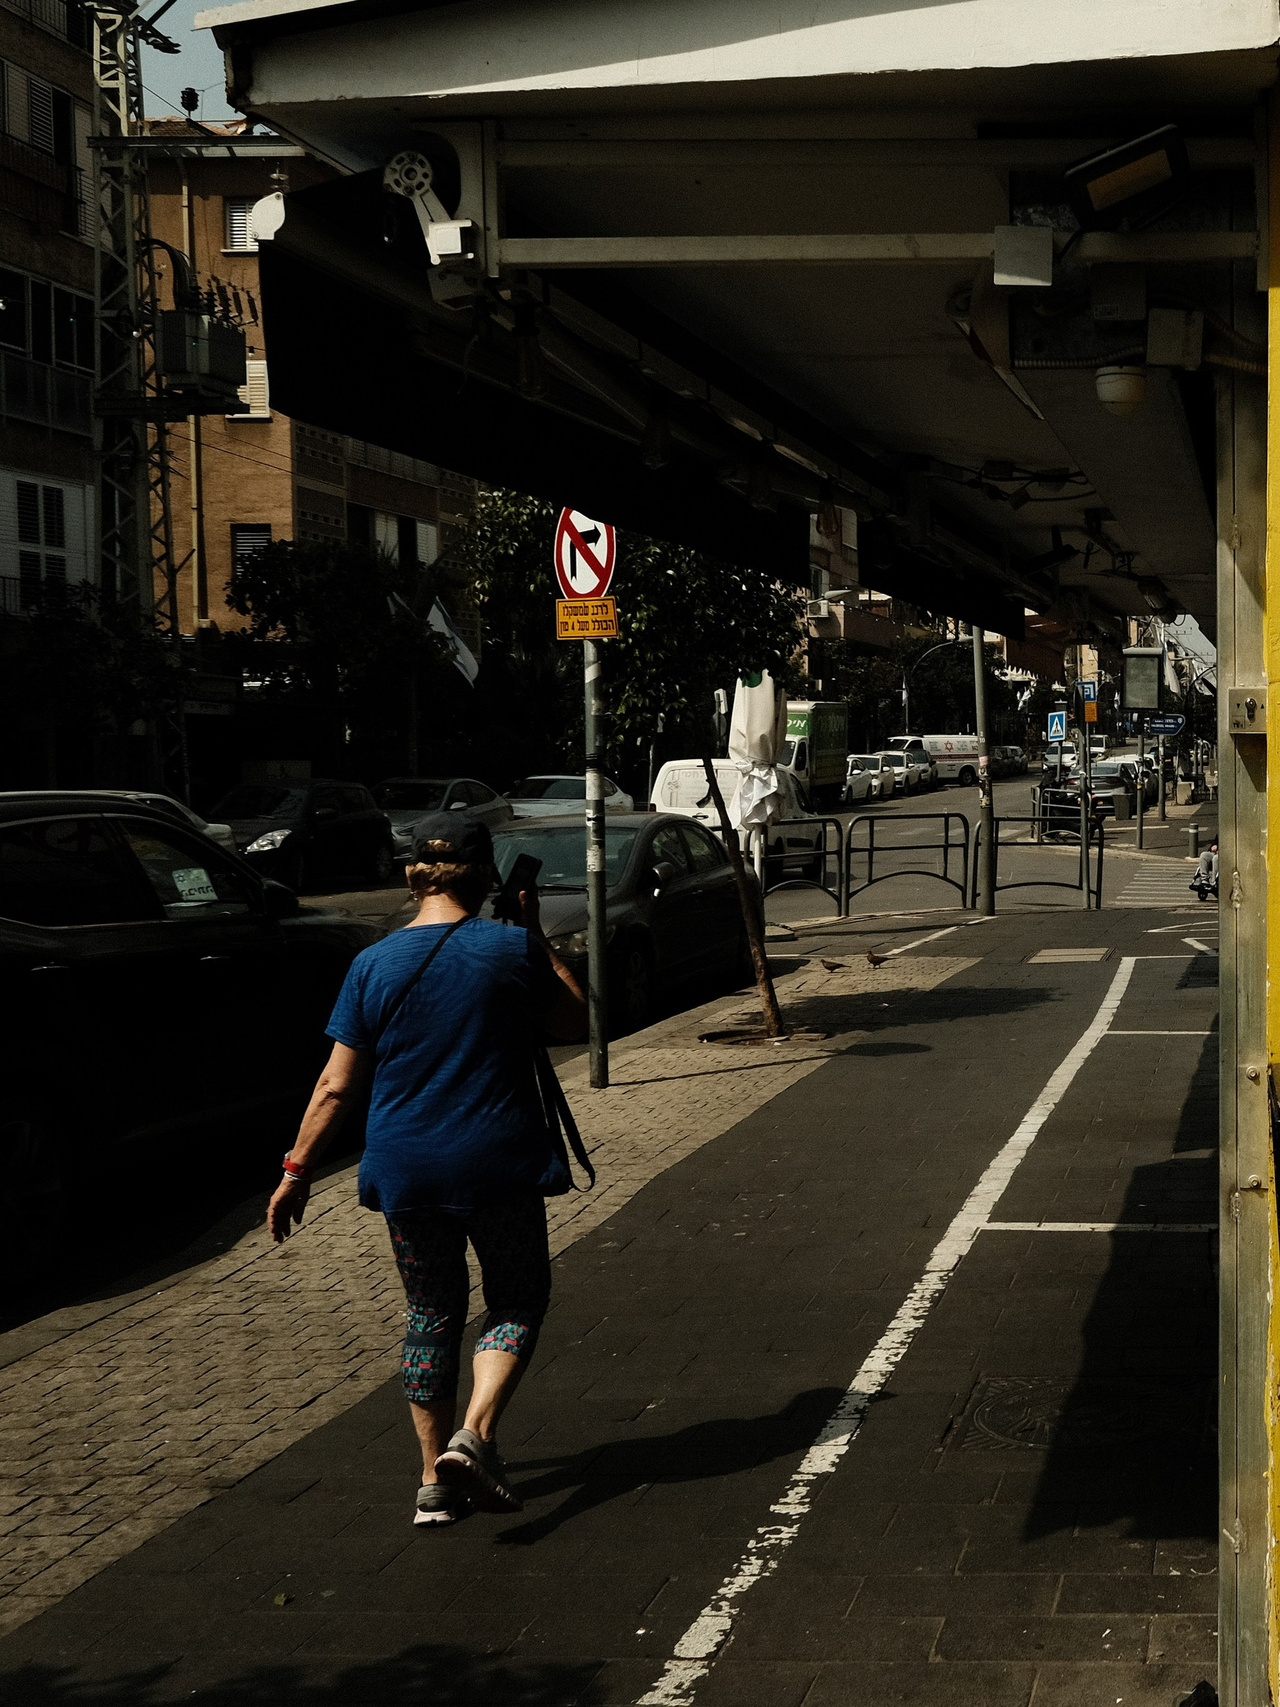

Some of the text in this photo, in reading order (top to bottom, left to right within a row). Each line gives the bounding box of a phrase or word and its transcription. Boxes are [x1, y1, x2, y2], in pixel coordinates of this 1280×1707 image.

[571, 621, 575, 630] 4
[577, 619, 589, 631] מעל
[591, 619, 614, 631] הכולל
